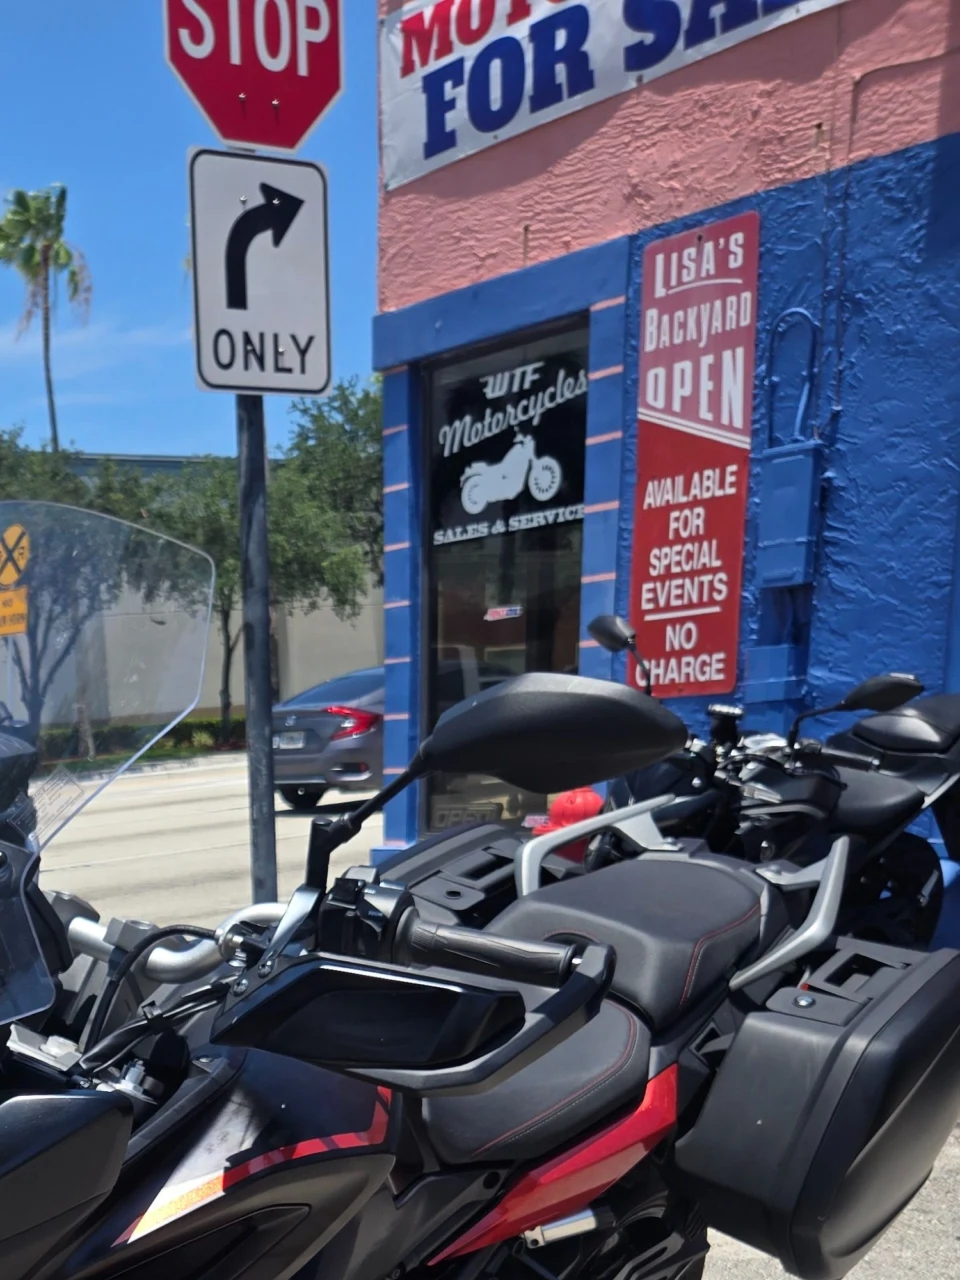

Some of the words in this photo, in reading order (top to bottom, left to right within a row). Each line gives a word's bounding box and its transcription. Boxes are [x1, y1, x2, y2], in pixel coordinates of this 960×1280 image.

[422, 4, 596, 160] FOR
[654, 232, 744, 298] LISA'S
[212, 328, 315, 375] ONLY
[479, 361, 545, 400] WTF
[645, 347, 744, 429] OPEN
[438, 368, 588, 457] Motorcycles
[643, 464, 738, 510] AVAILABLE
[433, 522, 489, 545] SALES
[491, 519, 506, 535] &
[508, 503, 586, 531] SERVICE
[668, 507, 705, 540] FOR
[649, 539, 722, 576] SPECIAL
[641, 572, 728, 610] EVENTS
[665, 621, 697, 652] NO
[635, 653, 726, 687] CHARGE
